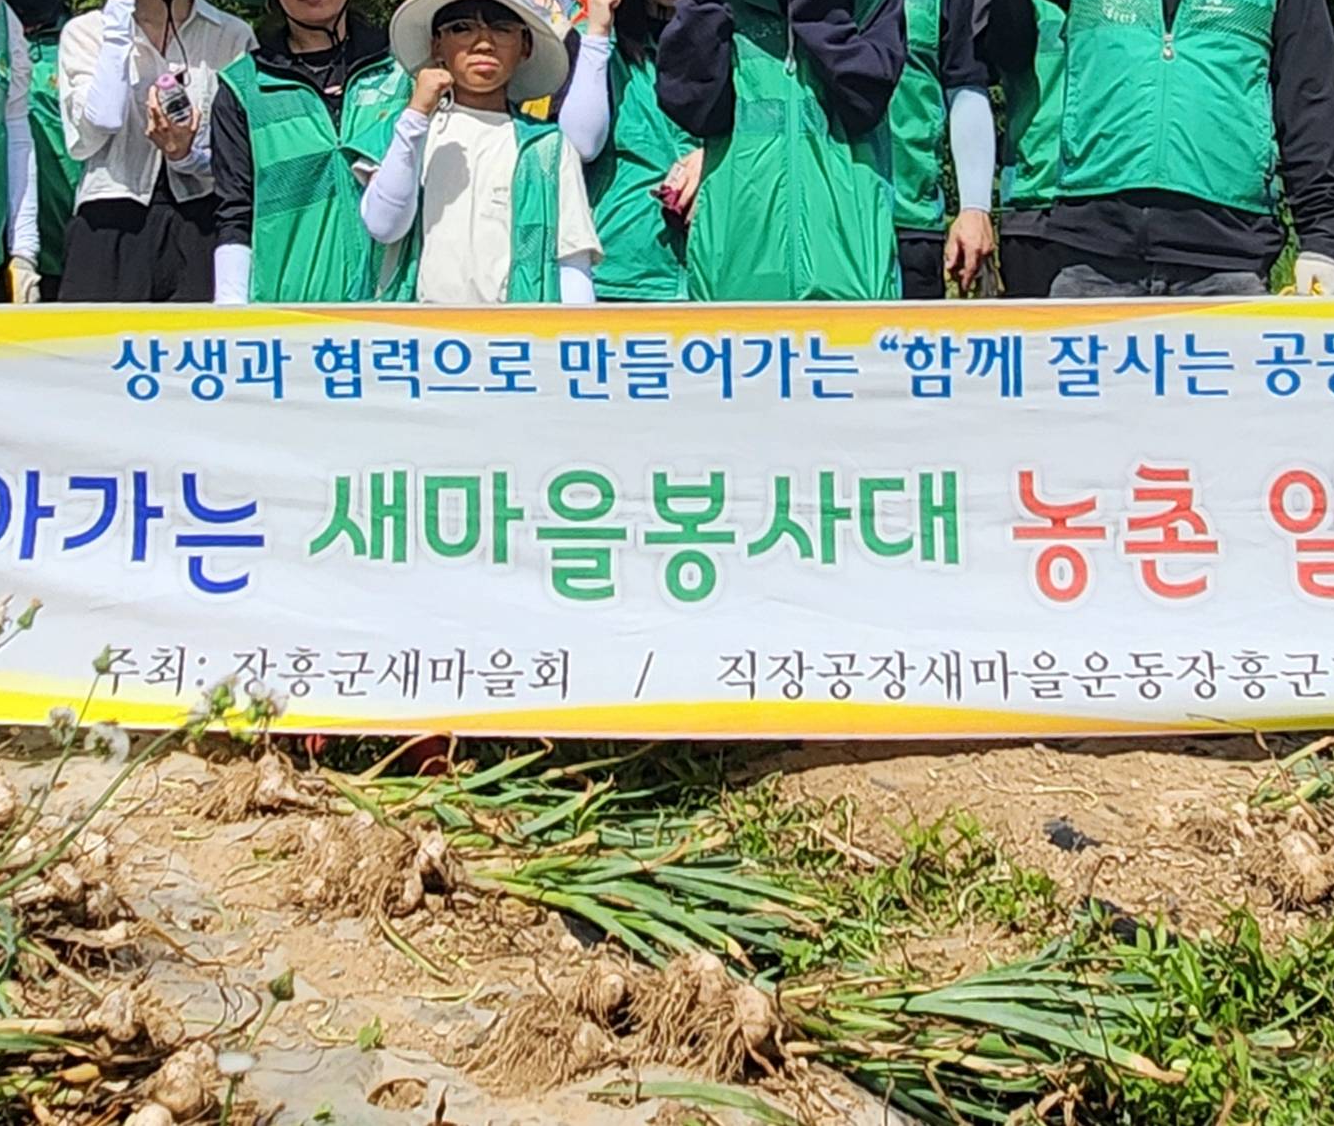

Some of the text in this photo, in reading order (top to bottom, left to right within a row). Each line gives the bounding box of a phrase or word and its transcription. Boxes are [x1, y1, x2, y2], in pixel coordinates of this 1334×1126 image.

[112, 337, 290, 402] 상생과
[312, 337, 536, 400] 협력으로
[558, 336, 858, 401] 만들어가는
[877, 333, 1024, 399] “함께
[1049, 332, 1235, 398] 잘사는
[307, 470, 960, 601] 새마을봉사대
[1012, 466, 1220, 601] 농촌
[96, 644, 207, 697] 주최:
[230, 647, 572, 700] 장흥군새마을회
